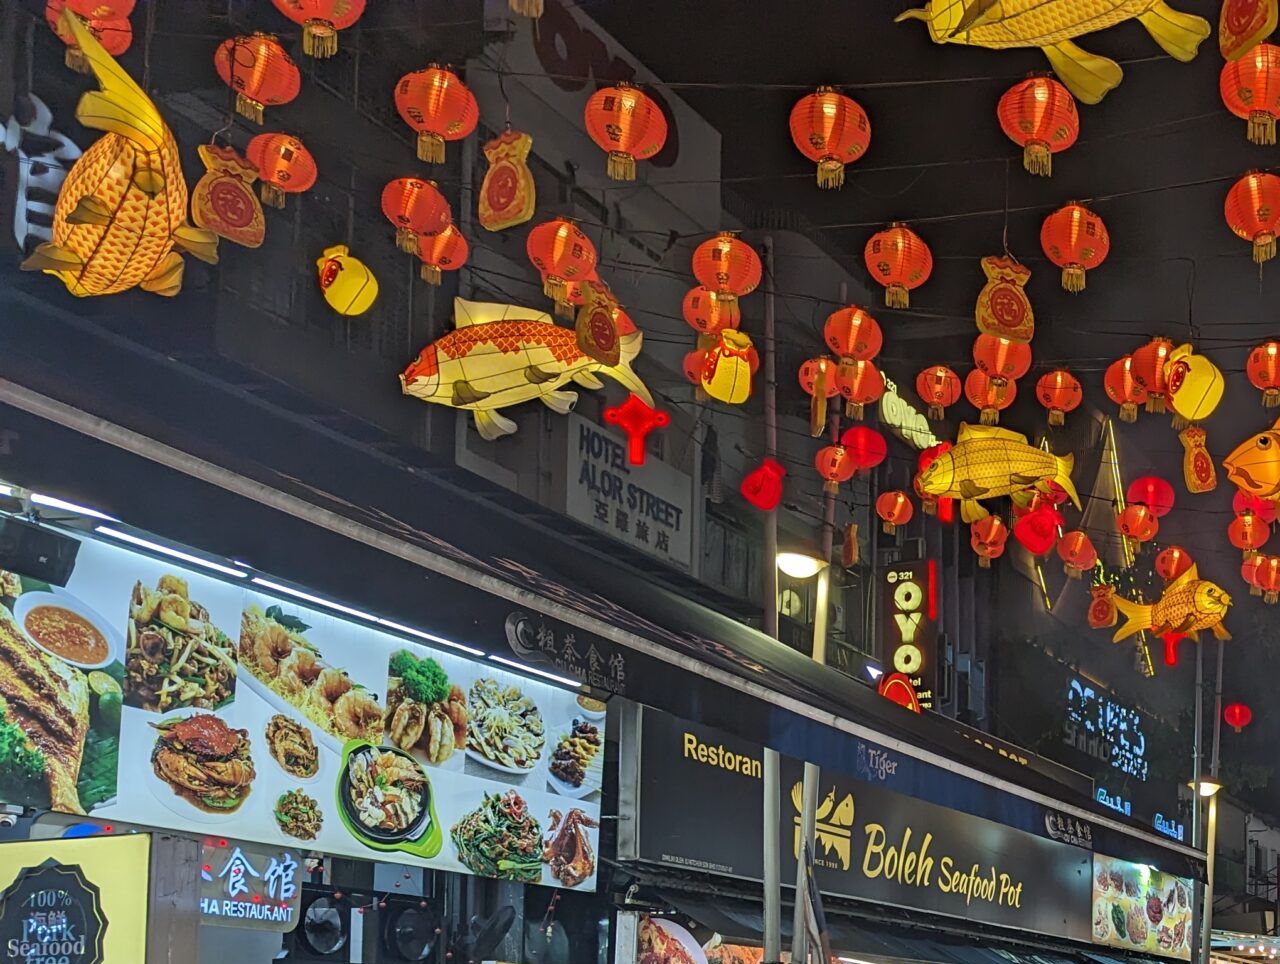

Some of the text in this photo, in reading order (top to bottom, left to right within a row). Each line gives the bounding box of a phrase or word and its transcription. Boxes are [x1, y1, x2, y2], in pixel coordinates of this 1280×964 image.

[579, 423, 631, 475] HOTEL
[578, 459, 683, 532] ALOR STREET
[898, 571, 913, 580] 321
[893, 581, 923, 675] OYO
[683, 732, 762, 779] Restoran
[868, 748, 898, 780] Tiger
[201, 847, 298, 901] 食馆
[862, 823, 1023, 909] Boleh Seafood Pot
[30, 889, 72, 907] 100%
[222, 900, 294, 922] RESTAURANT
[7, 935, 85, 958] Seafood
